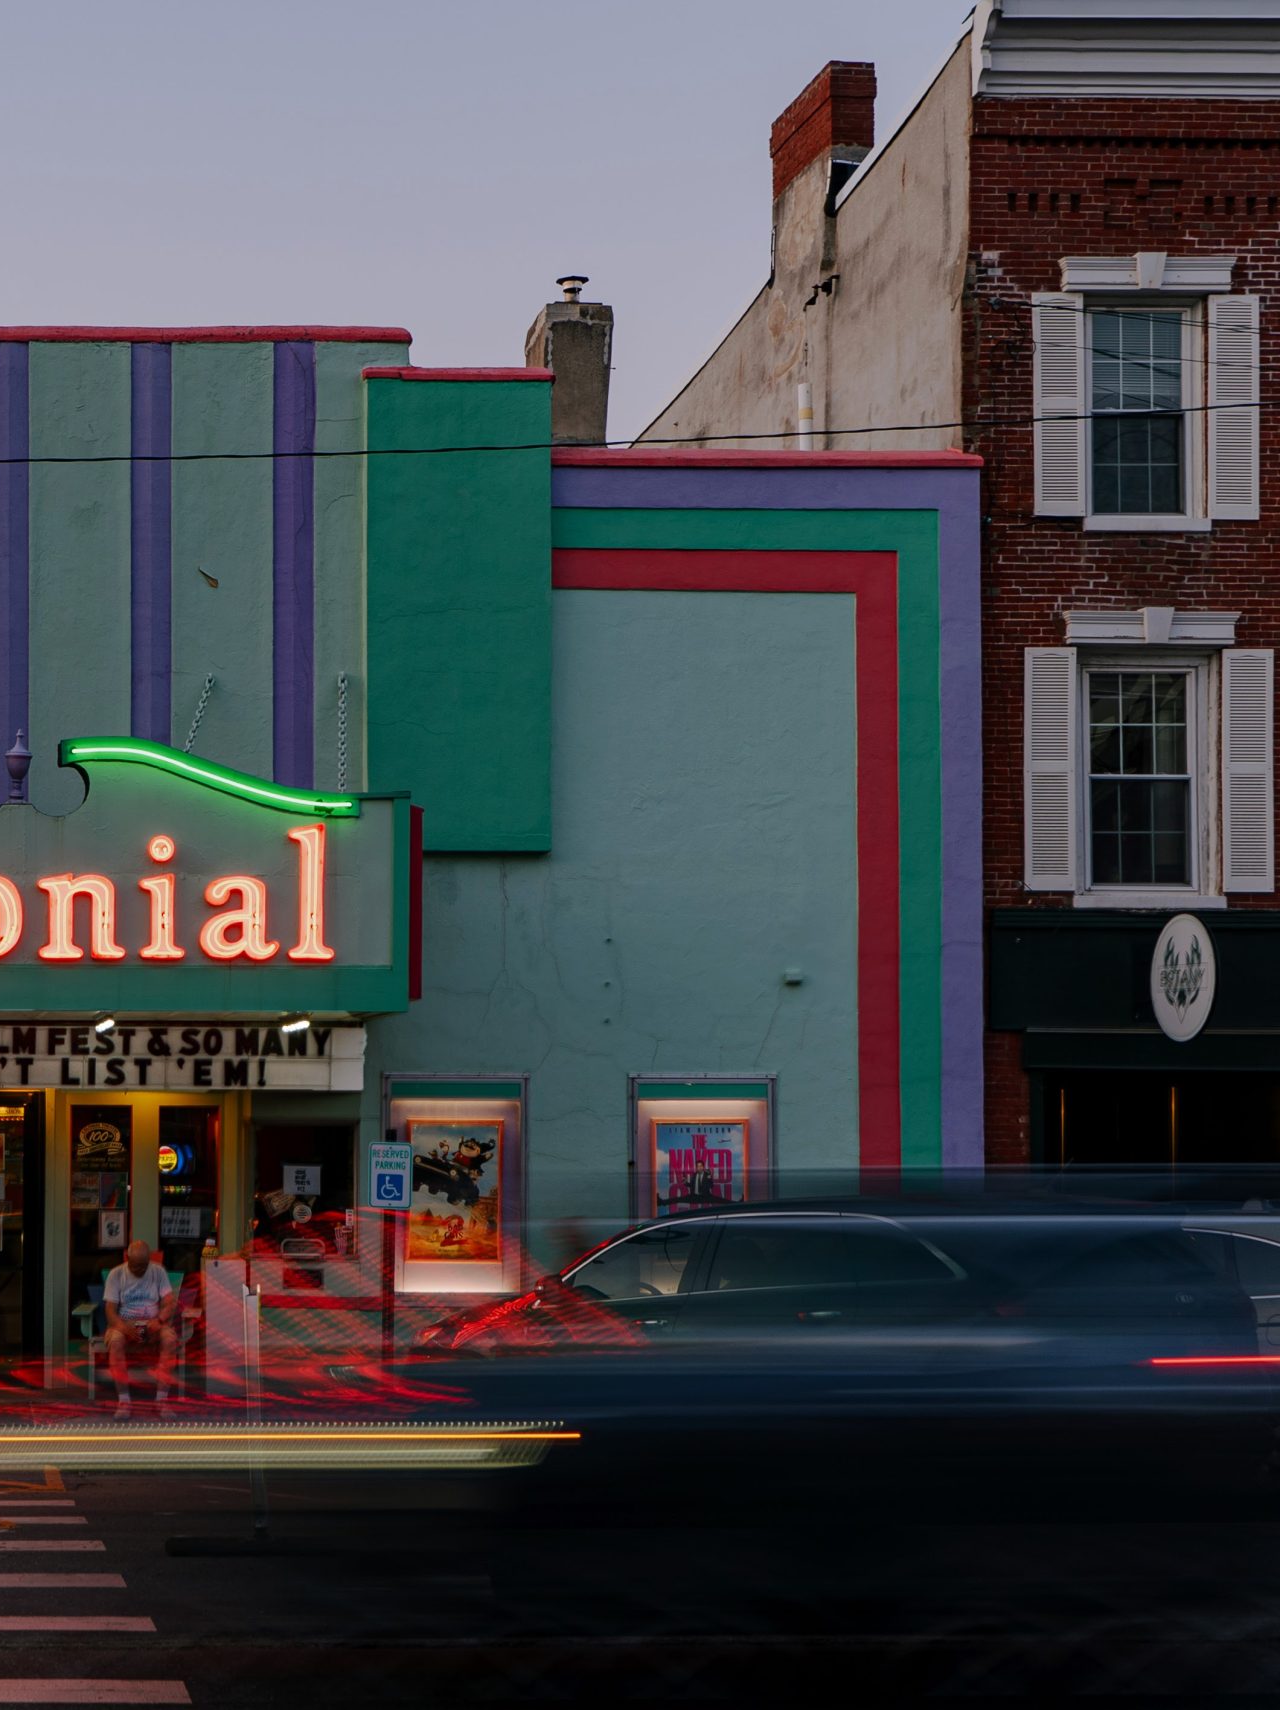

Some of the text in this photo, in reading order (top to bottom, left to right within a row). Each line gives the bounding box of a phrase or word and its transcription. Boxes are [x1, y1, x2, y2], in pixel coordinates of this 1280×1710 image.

[48, 1027, 135, 1056] FEST
[147, 1028, 172, 1056] &
[179, 1028, 223, 1056] SO
[235, 1028, 332, 1056] MANY
[61, 1057, 152, 1086] LIST
[176, 1058, 267, 1086] 'EM!
[692, 1134, 707, 1149] THE
[372, 1150, 410, 1159] RESERVED
[375, 1161, 407, 1170] PARKING
[669, 1149, 732, 1184] NAKED
